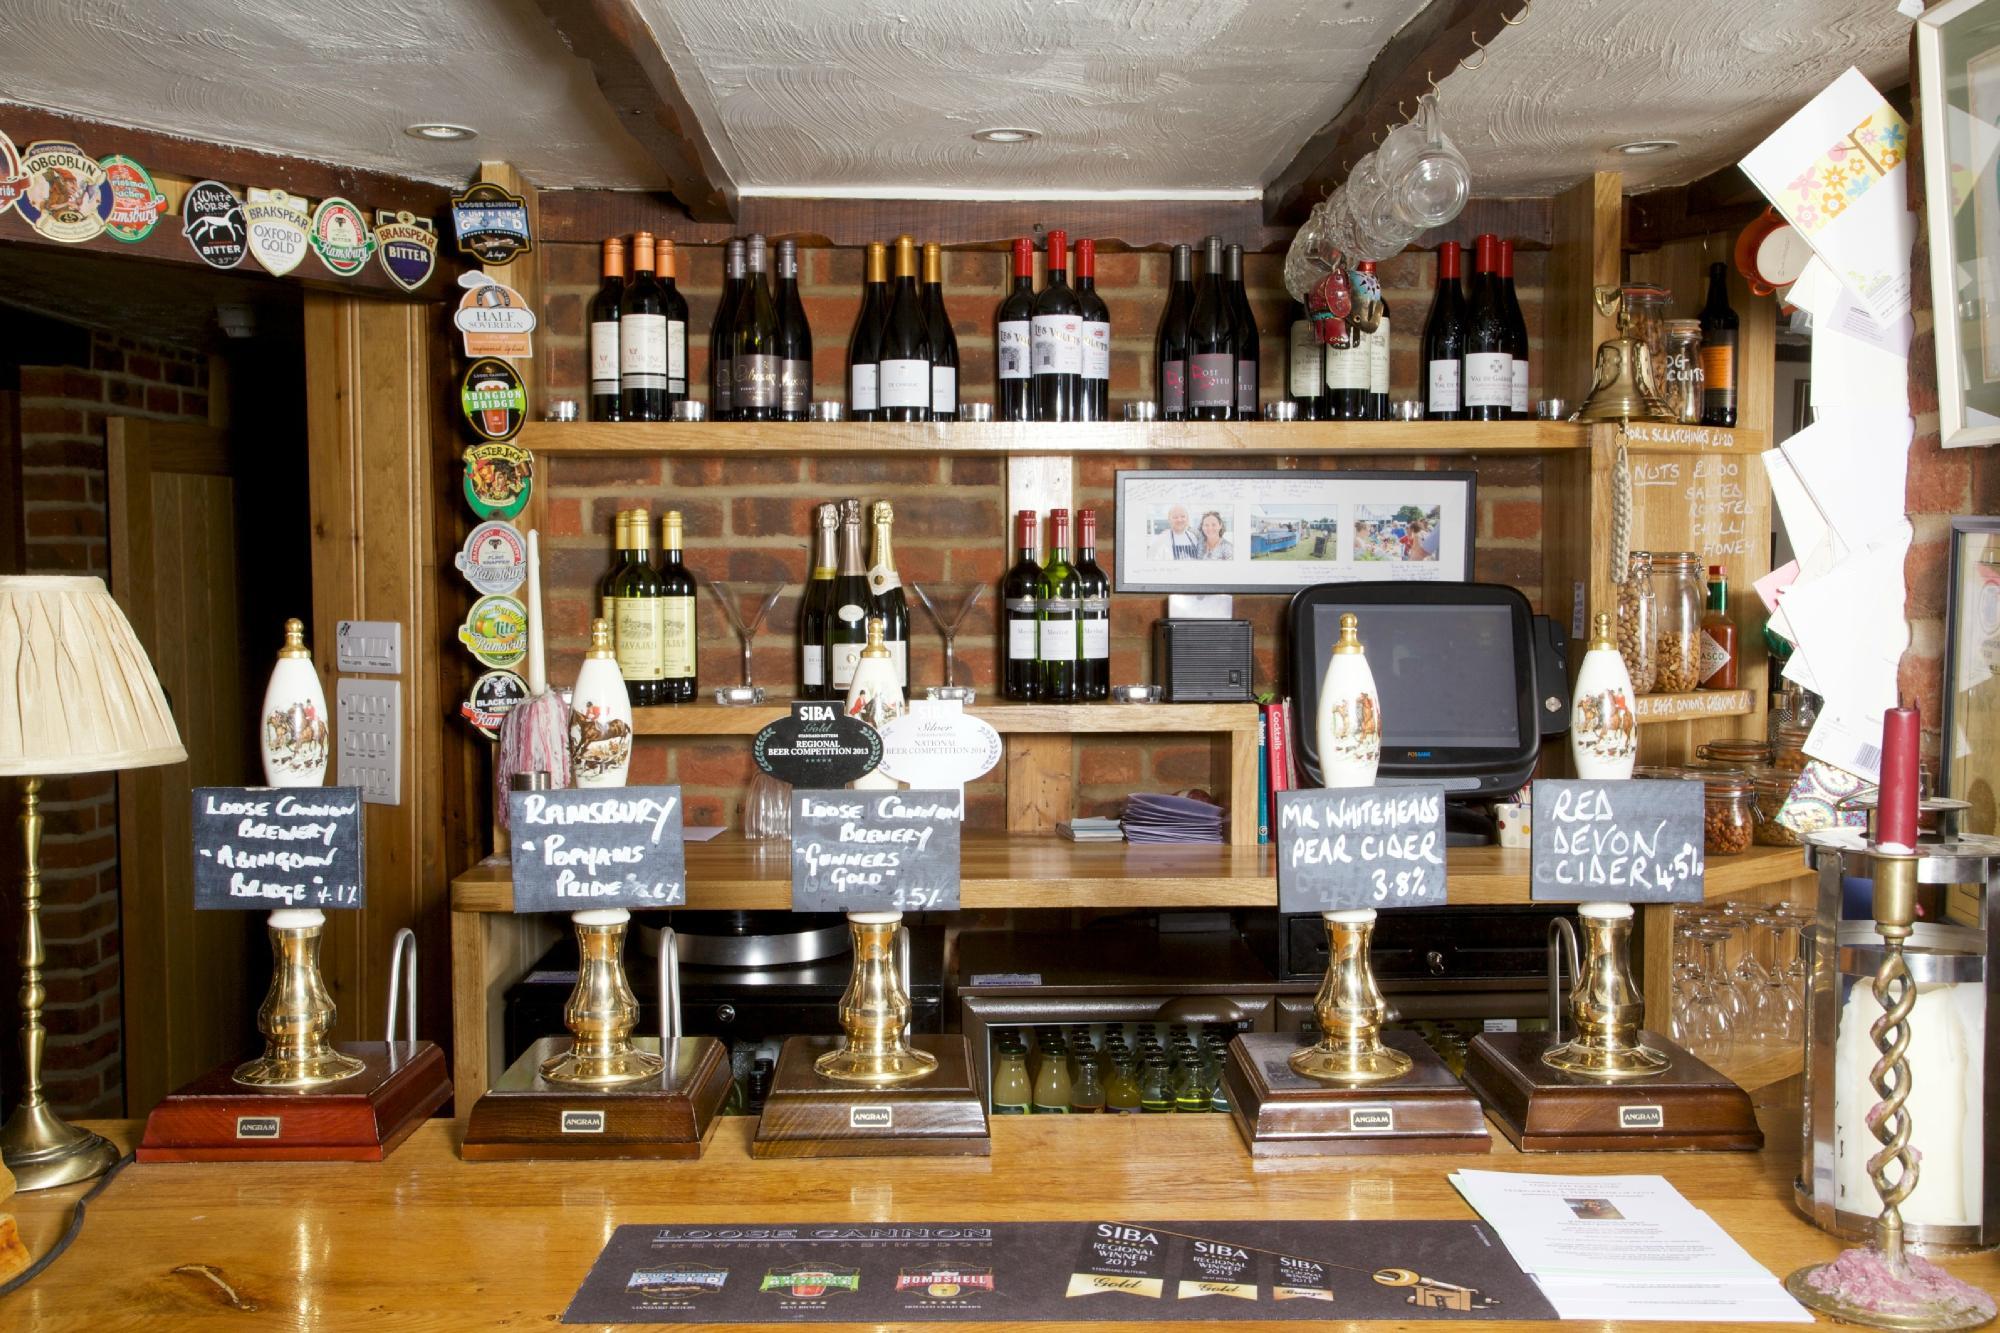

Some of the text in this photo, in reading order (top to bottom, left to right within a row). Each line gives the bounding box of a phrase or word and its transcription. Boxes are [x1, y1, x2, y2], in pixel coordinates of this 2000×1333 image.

[197, 190, 233, 203] White
[248, 206, 309, 231] BRAKSPEAR
[253, 225, 302, 243] OXFORD
[380, 226, 435, 248] BRAKSPEAR
[203, 245, 241, 255] BITTER
[261, 241, 295, 255] GOLD
[388, 246, 428, 263] BITTER
[476, 311, 515, 321] HALF
[468, 321, 523, 329] SOVEREIGN
[1034, 323, 1048, 336] LES
[464, 390, 521, 401] ABINGDON
[473, 400, 515, 409] BRIDGE
[1635, 463, 1680, 480] NUTS
[1684, 483, 1744, 500] SALTED
[1692, 521, 1745, 536] CHILLI
[1703, 540, 1754, 557] HONEY
[476, 697, 521, 707] BLACK RA
[800, 706, 836, 721] SIBA
[803, 722, 833, 733] Gold
[1273, 711, 1282, 750] Cocktails
[796, 740, 840, 748] REGIONAL
[768, 747, 869, 756] BEER COMPETITION 2013
[1552, 788, 1613, 823] RED
[524, 794, 677, 845] RAMSBURY
[1282, 796, 1440, 830] MR WHITEHEADS
[1554, 819, 1667, 859] DEVON
[1292, 830, 1445, 868] PEAR CIDER
[1555, 854, 1653, 890] CIDER
[830, 867, 882, 893] GOLD
[855, 1113, 892, 1121] ANGRAM
[656, 1228, 992, 1240] LOOSE CANNON
[1097, 1223, 1159, 1245] SIBA
[1093, 1242, 1155, 1257] REGIONAL
[1099, 1250, 1148, 1262] WINNER
[1194, 1241, 1249, 1260] SIBA
[1105, 1258, 1137, 1267] 2013
[1193, 1256, 1247, 1268] REGIONAL
[1199, 1262, 1242, 1273] WINNER
[1280, 1256, 1324, 1271] SIBA
[902, 1275, 986, 1285] BOMBSHELL
[1280, 1268, 1322, 1279] REGIONAL
[1093, 1277, 1142, 1289] Gold
[1199, 1284, 1240, 1293] Gold
